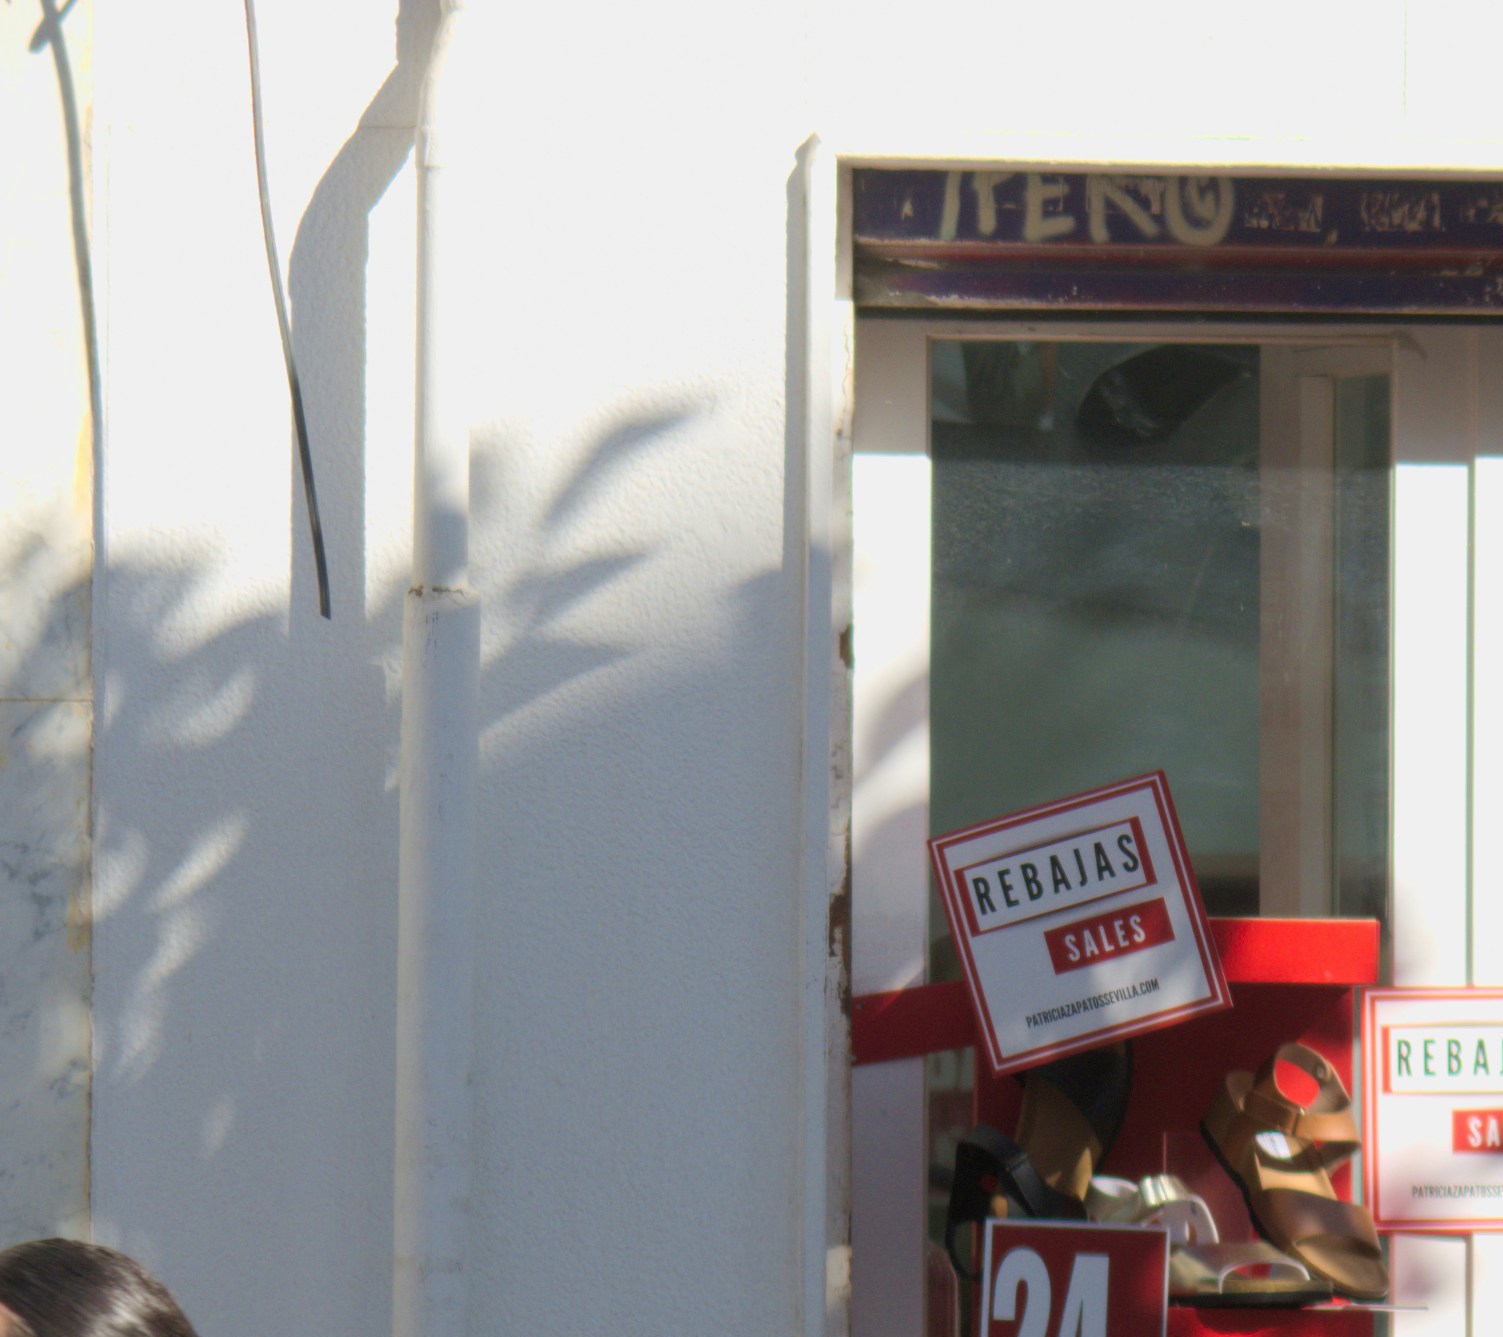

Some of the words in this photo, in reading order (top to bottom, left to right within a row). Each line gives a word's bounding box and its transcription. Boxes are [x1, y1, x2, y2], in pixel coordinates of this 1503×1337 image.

[972, 834, 1139, 915] REBAJAS
[1065, 914, 1145, 962] SALES
[1026, 978, 1160, 1028] PATRICIAZAPATOSSEVILLA.COM
